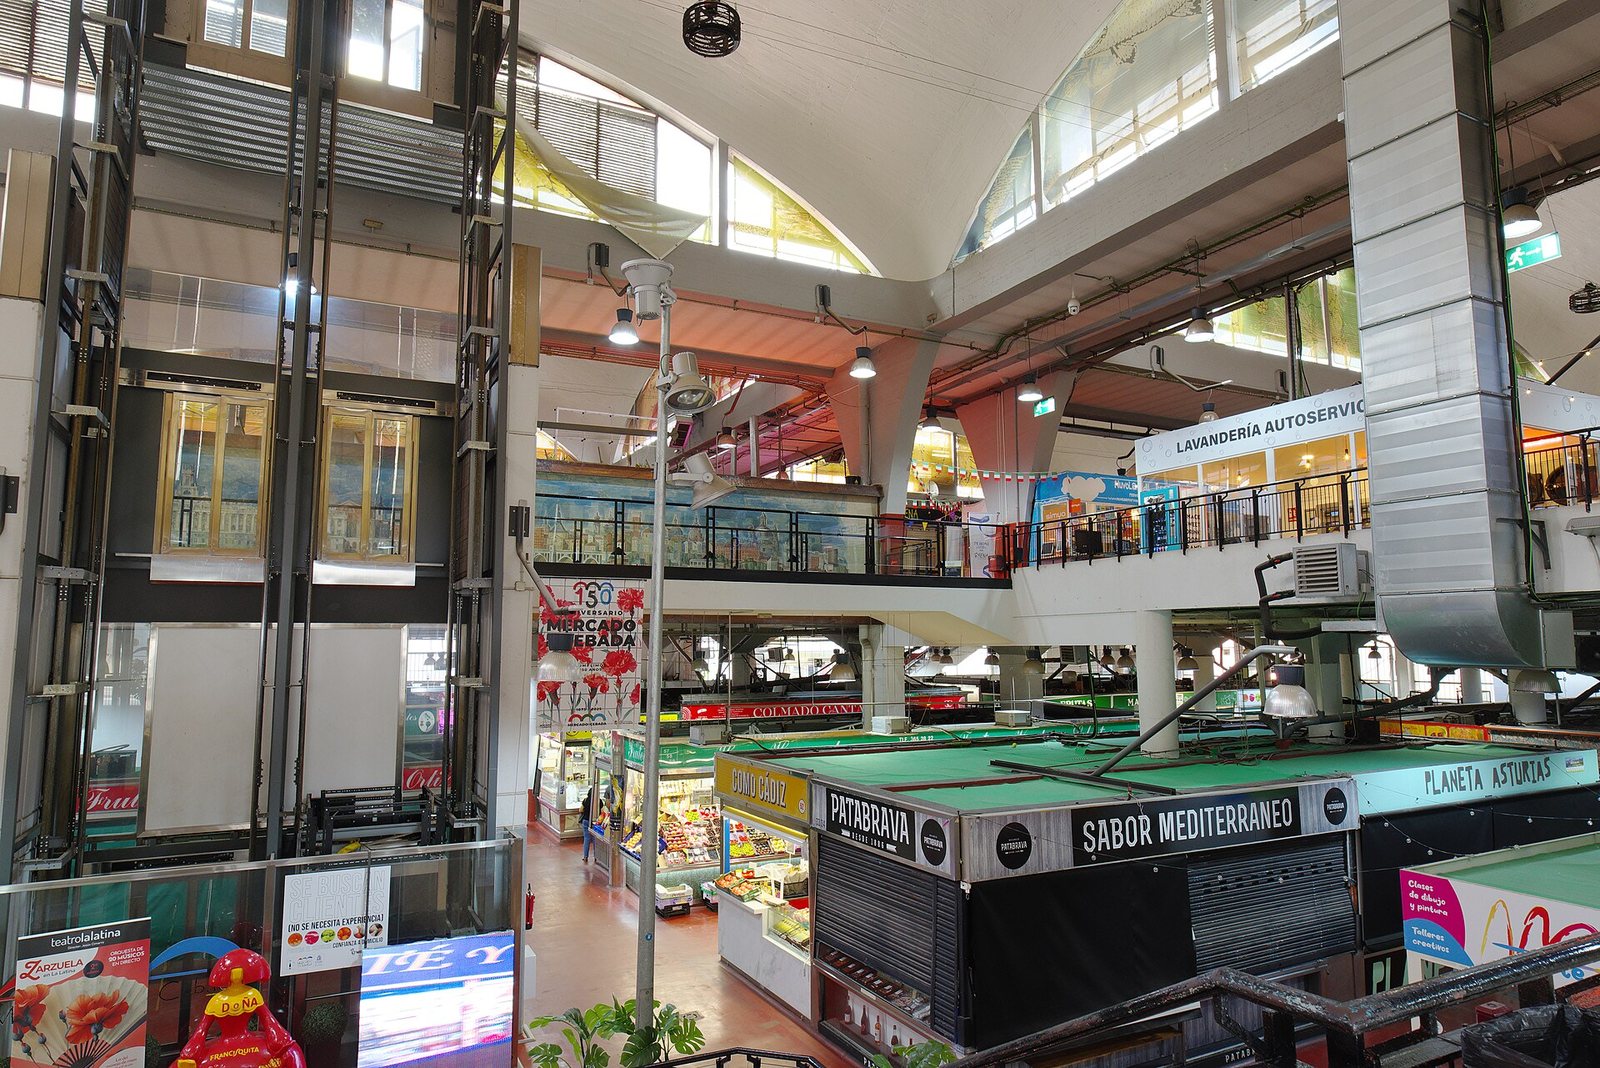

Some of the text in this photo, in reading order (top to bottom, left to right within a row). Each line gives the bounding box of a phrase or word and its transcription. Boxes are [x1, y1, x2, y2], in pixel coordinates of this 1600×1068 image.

[1176, 422, 1262, 454] LAVANDERÍA
[546, 619, 636, 632] MERCADO
[574, 634, 636, 647] EBADA
[753, 705, 819, 718] COLMADO
[1424, 765, 1484, 795] PLANETA
[1492, 756, 1551, 789] ASTURIAS
[732, 768, 787, 808] COMO CÁDIZ
[830, 792, 910, 845] PATABRAVA
[1083, 798, 1292, 853] SABOR MEDITERRANEO
[1001, 841, 1027, 851] PATABRAVA
[1408, 880, 1434, 892] Clases
[1409, 891, 1446, 906] de dibujo
[1410, 903, 1448, 916] y pintura
[302, 922, 309, 931] SE
[311, 919, 340, 930] NECESITA
[51, 929, 121, 947] teatrolalatina
[1411, 926, 1445, 942] Talleres
[110, 948, 136, 956] ORQUESTA
[1412, 938, 1449, 954] creativos
